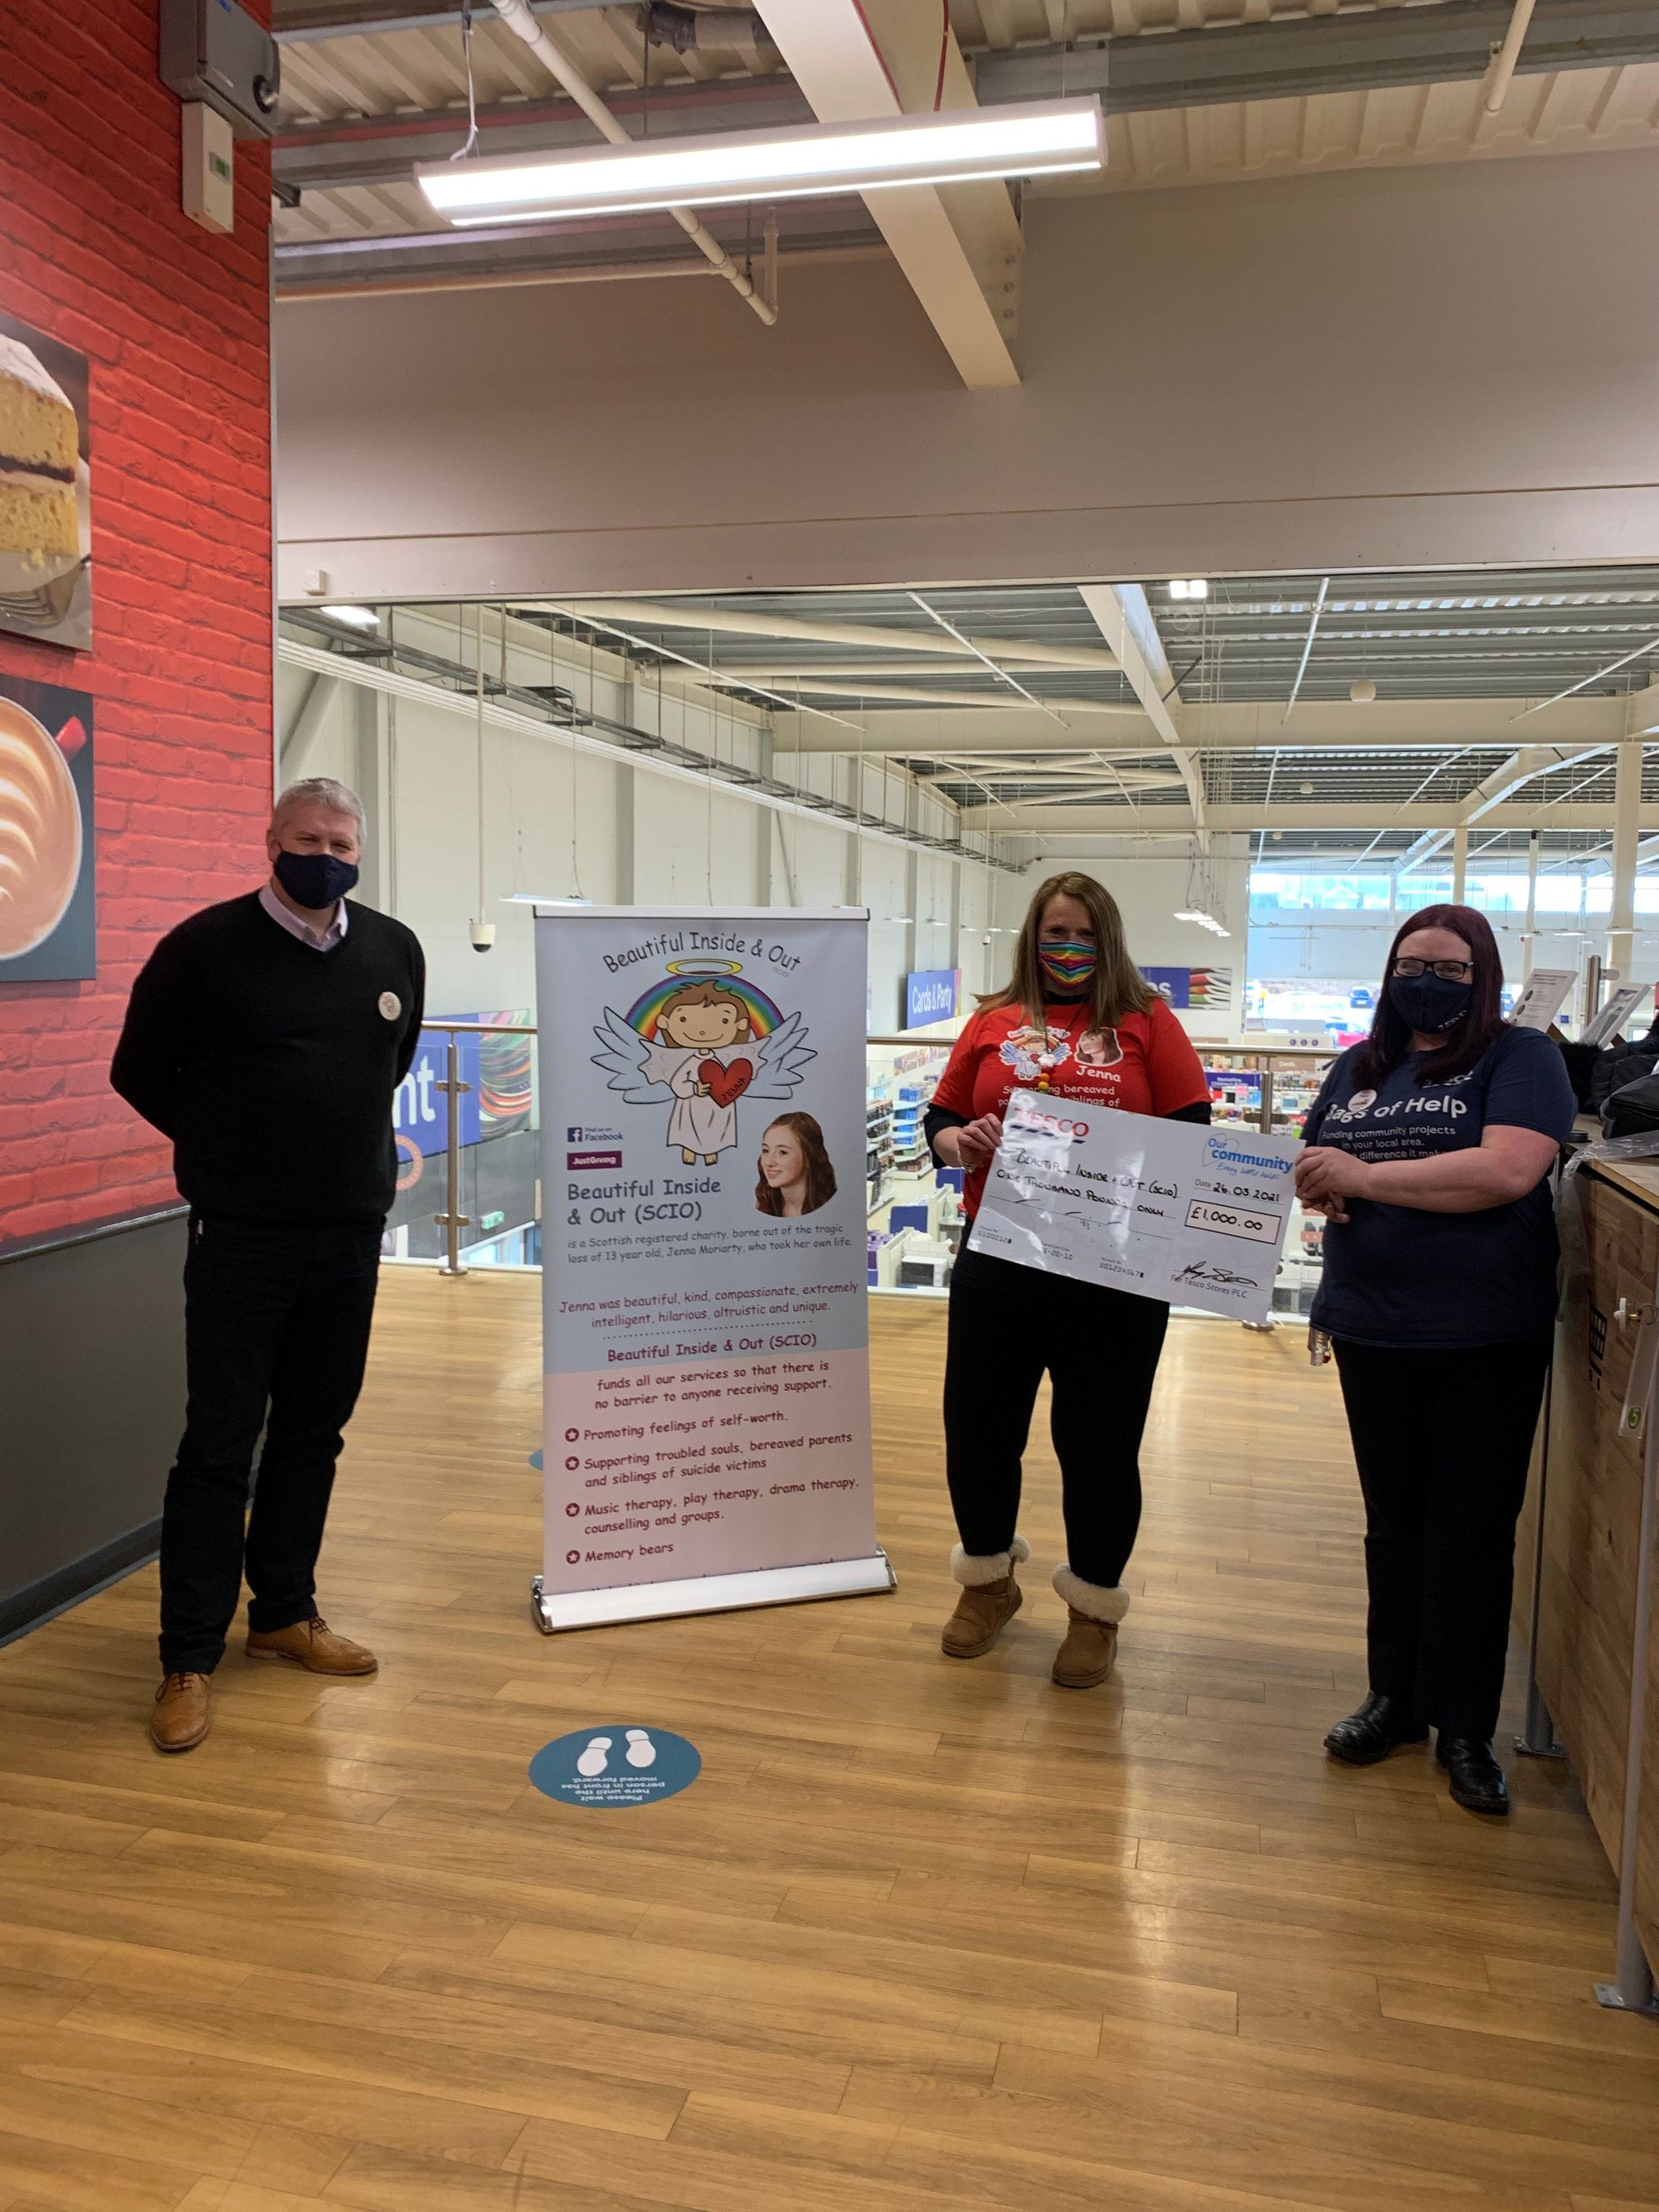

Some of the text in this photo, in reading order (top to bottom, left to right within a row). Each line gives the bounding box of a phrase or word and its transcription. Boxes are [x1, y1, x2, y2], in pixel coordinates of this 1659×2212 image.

[603, 932, 801, 973] Beautiful Inside & Out
[912, 983, 952, 1014] Cards & Party
[1076, 1065, 1121, 1082] Jenna
[1063, 1084, 1115, 1096] bereaved
[1108, 1098, 1121, 1108] of
[1374, 1101, 1404, 1118] of
[1404, 1095, 1467, 1119] Help
[1014, 1107, 1089, 1137] TESCO
[1355, 1126, 1407, 1139] community
[1408, 1125, 1456, 1136] projects
[585, 1132, 624, 1141] Facebook
[1208, 1138, 1228, 1149] Our
[1342, 1138, 1425, 1150] in your local area.
[1211, 1150, 1294, 1174] community
[1360, 1150, 1408, 1160] difference
[1409, 1150, 1416, 1158] it
[567, 1177, 721, 1200] Beautiful Inside
[1149, 1180, 1177, 1199] (SCIO)
[1194, 1179, 1211, 1188] Date
[567, 1201, 702, 1225] & Out (SCIO)
[568, 1239, 577, 1248] is
[589, 1236, 632, 1247] Scottish
[635, 1232, 688, 1246] registered
[763, 1228, 778, 1236] out
[781, 1225, 791, 1235] of
[795, 1225, 811, 1234] the
[815, 1223, 843, 1236] tragic
[591, 1252, 602, 1262] of
[606, 1251, 616, 1261] 13
[620, 1251, 642, 1262] year
[667, 1247, 696, 1257] Jenna
[748, 1242, 766, 1251] who
[770, 1240, 791, 1249] took
[794, 1239, 810, 1248] her
[813, 1240, 831, 1248] own
[559, 1301, 596, 1313] Jenna
[599, 1300, 620, 1310] was
[803, 1281, 859, 1295] extremely
[1185, 1277, 1204, 1288] Tesco
[1206, 1282, 1229, 1295] Stores
[1232, 1288, 1248, 1299] PLC
[714, 1305, 766, 1318] altruistic
[769, 1302, 789, 1314] and
[792, 1301, 830, 1314] unique.
[608, 1333, 816, 1362] Beautiful Inside & Out (SCIO)
[597, 1360, 829, 1391] funds all our services so that there is
[595, 1378, 832, 1409] no barrier to anyone receiving support.
[584, 1411, 788, 1441] Promoting feelings of self-worth.
[584, 1453, 649, 1471] Supporting
[655, 1446, 706, 1461] troubled
[750, 1437, 804, 1451] bereaved
[809, 1432, 853, 1449] parents
[585, 1459, 766, 1488] and siblings of suicide victims
[584, 1502, 620, 1516] Music
[684, 1492, 708, 1508] play
[770, 1484, 805, 1495] drama
[584, 1510, 724, 1534] counselling and groups.
[585, 1544, 674, 1563] Memory bears
